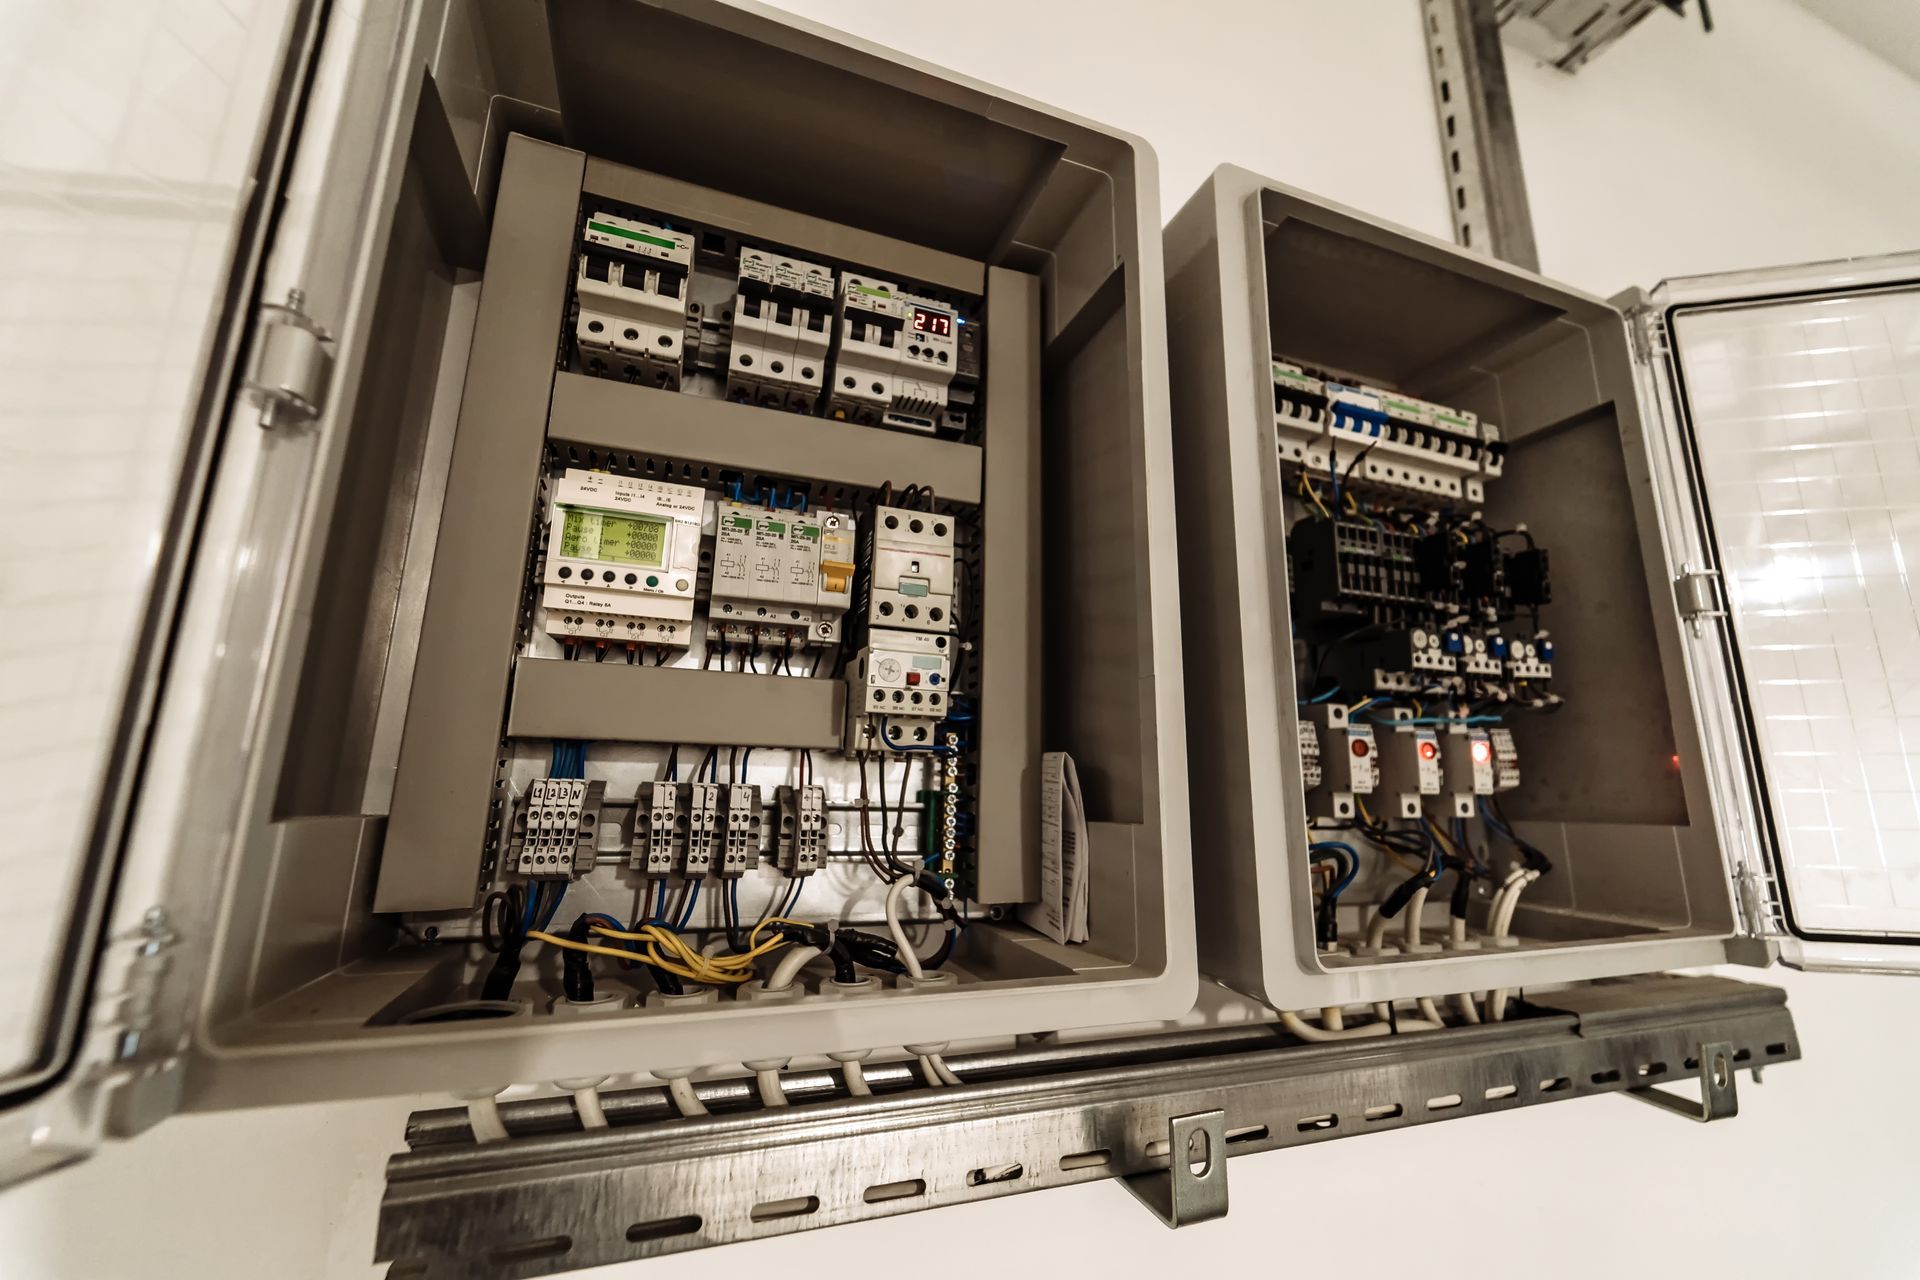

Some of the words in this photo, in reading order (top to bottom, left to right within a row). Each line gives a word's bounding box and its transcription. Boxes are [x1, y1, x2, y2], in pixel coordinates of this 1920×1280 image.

[914, 314, 948, 334] 217
[567, 512, 584, 522] Mix
[590, 516, 616, 527] timer
[566, 524, 594, 534] Pause
[565, 533, 587, 543] Aero
[564, 542, 592, 552] Pause
[533, 788, 543, 798] L1
[546, 788, 556, 800] L2
[559, 787, 568, 799] L3
[572, 790, 581, 800] N
[668, 791, 673, 800] 1
[708, 792, 714, 801] 2
[743, 792, 750, 802] 4
